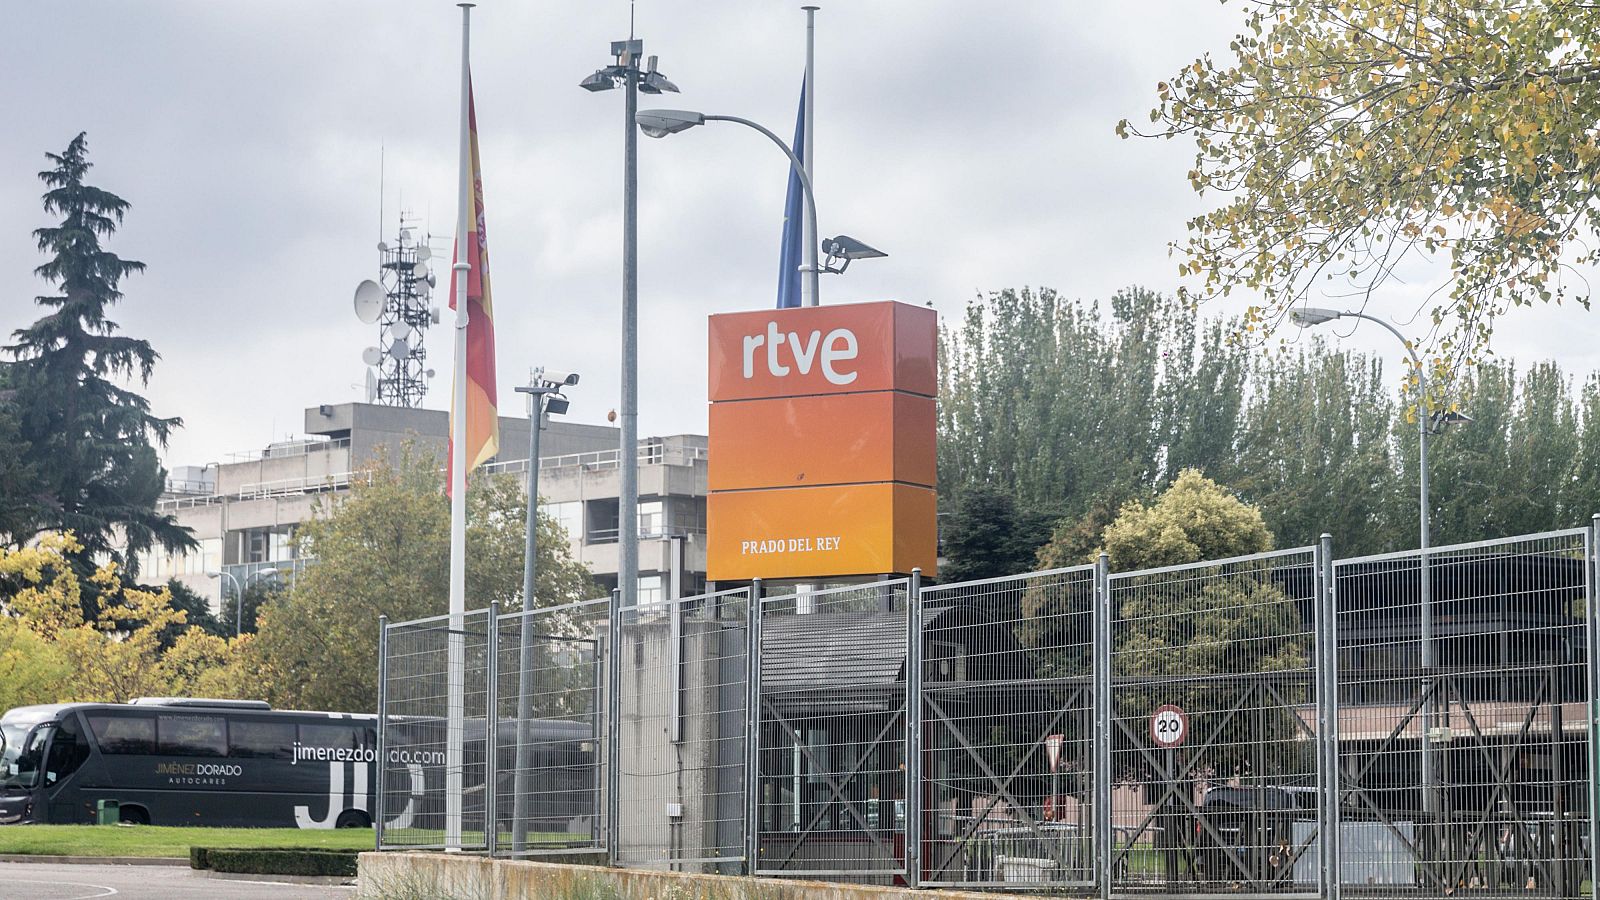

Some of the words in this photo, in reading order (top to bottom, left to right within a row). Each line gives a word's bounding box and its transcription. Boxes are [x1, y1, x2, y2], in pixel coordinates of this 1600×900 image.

[743, 321, 858, 385] rtve
[741, 538, 786, 554] PRADO
[788, 538, 813, 552] DEL
[816, 536, 841, 550] REY
[1158, 719, 1179, 733] 20
[197, 763, 242, 776] DORADO
[169, 777, 226, 785] AUTOCARES
